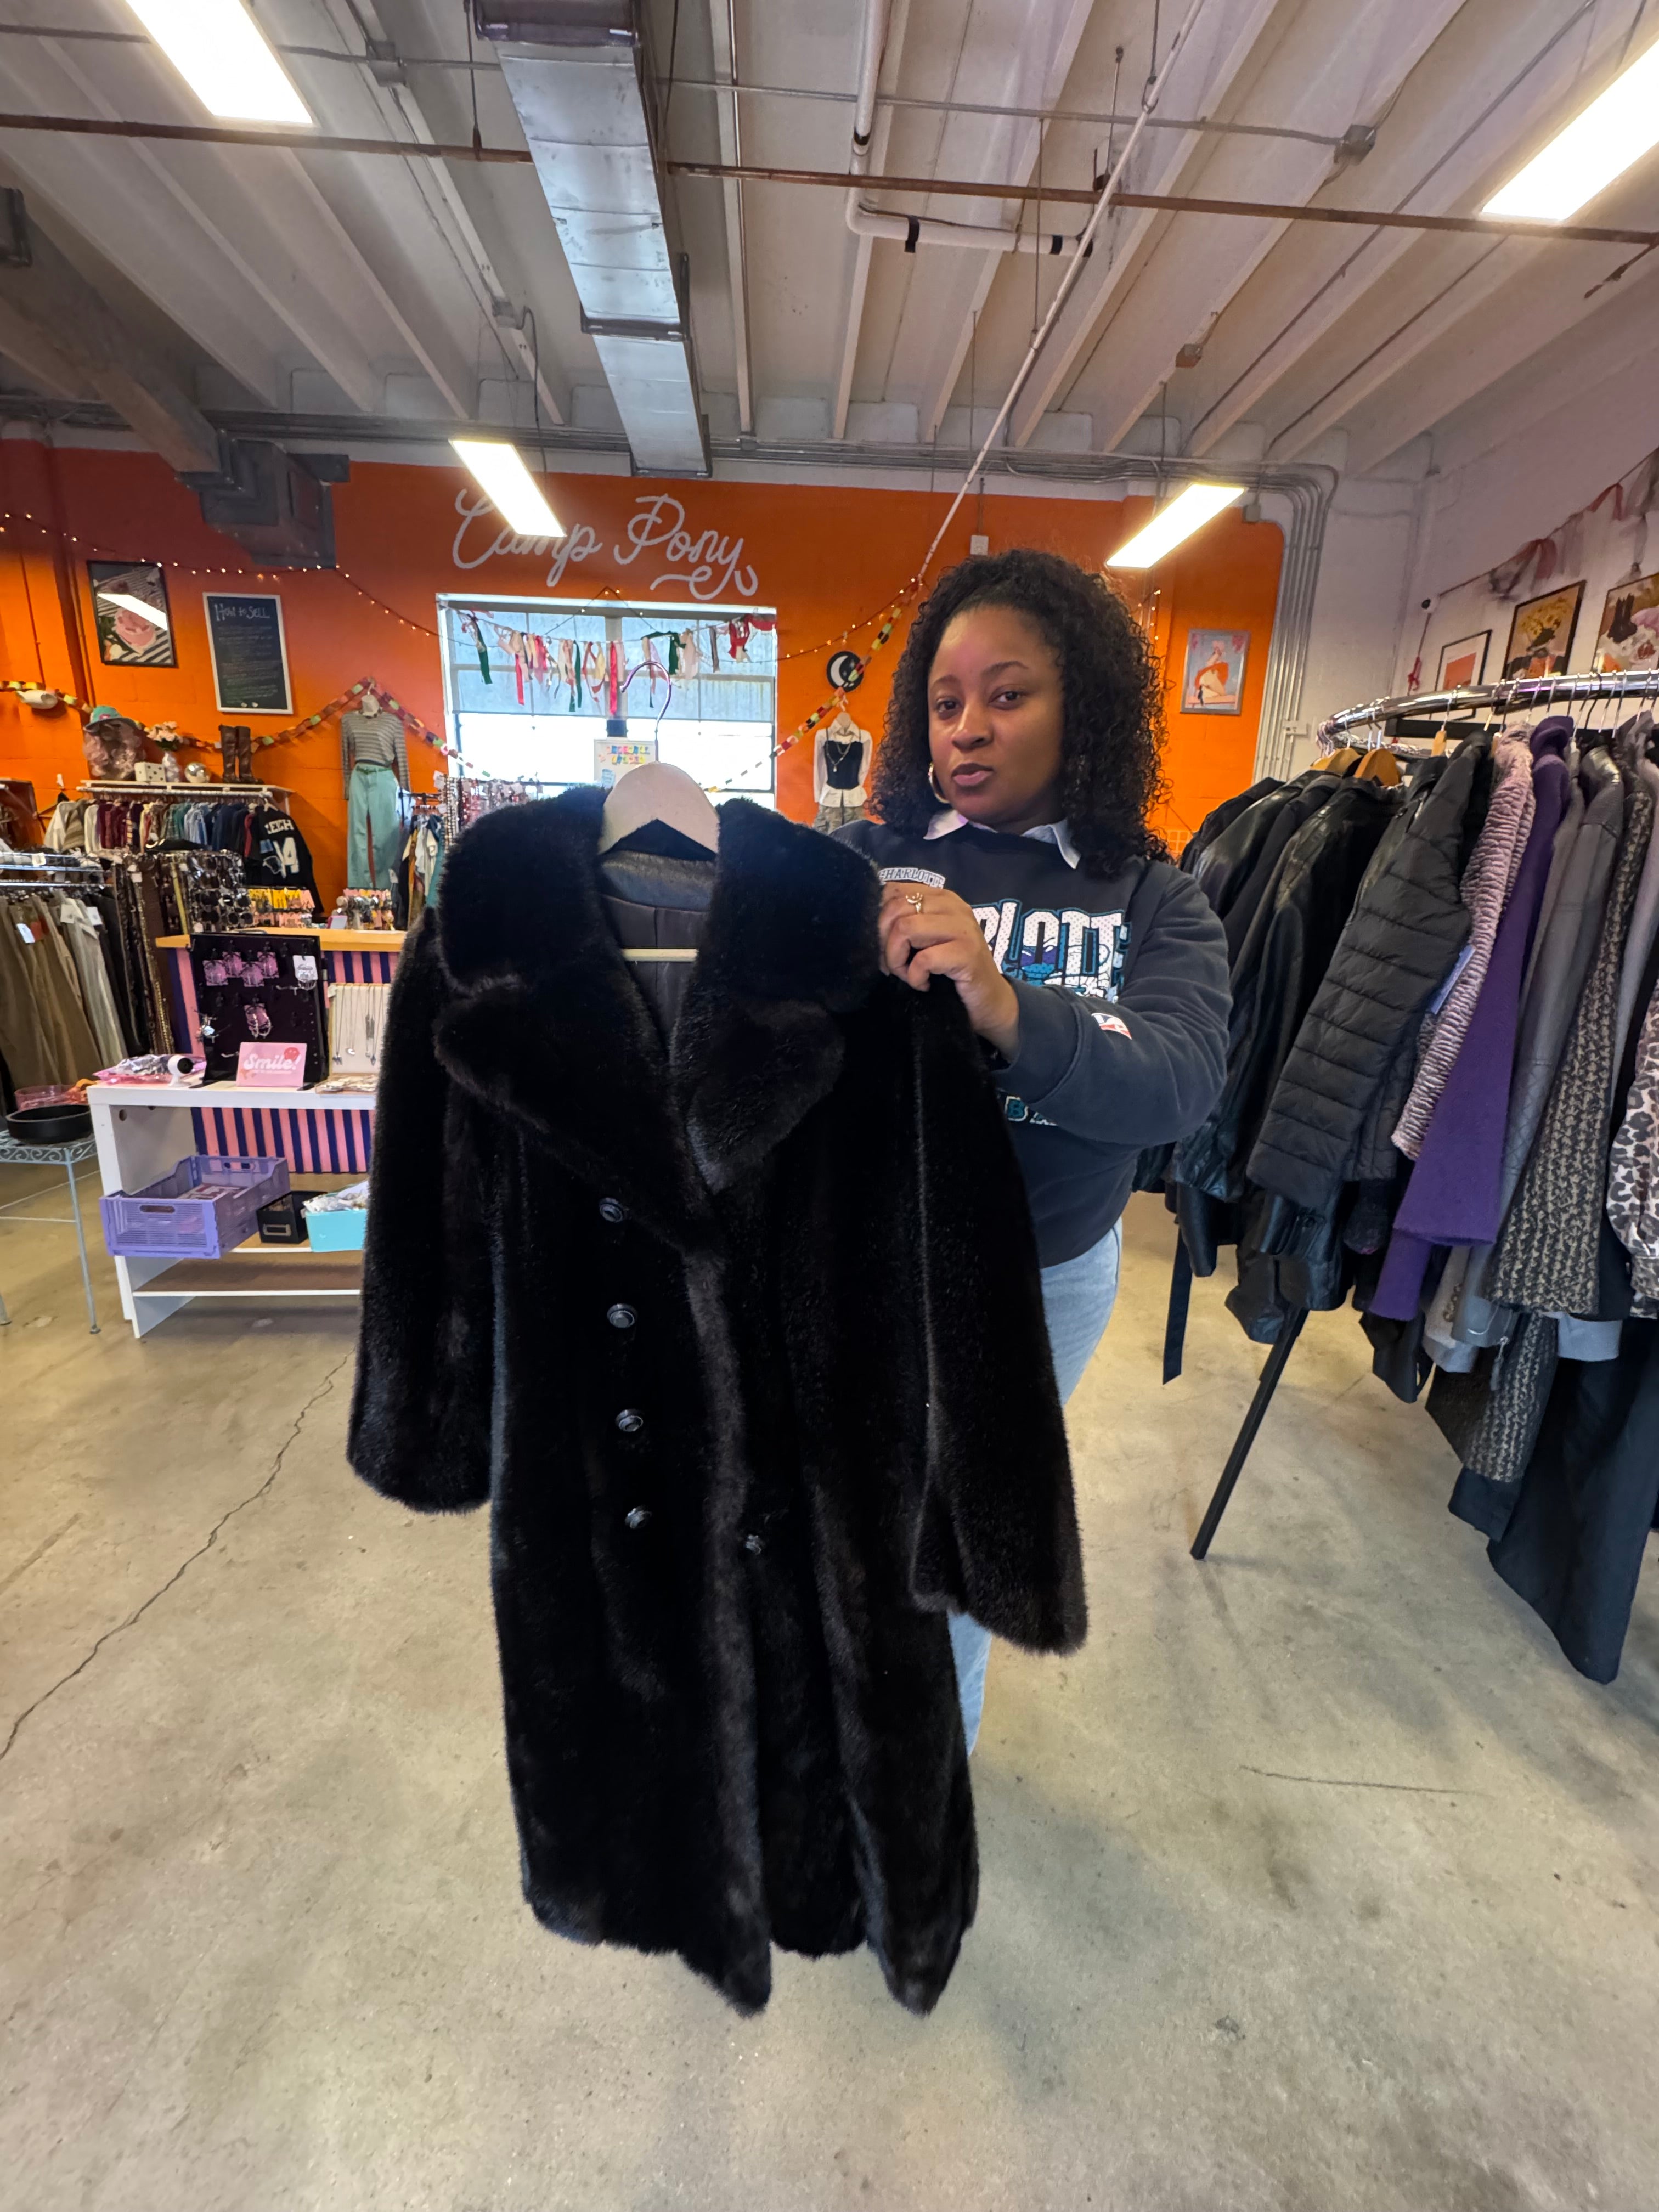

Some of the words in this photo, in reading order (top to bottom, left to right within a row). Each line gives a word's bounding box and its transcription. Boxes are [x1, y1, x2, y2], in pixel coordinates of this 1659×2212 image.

[453, 489, 602, 588] Camp
[614, 493, 759, 601] Pony
[244, 1053, 302, 1070] Smile!
